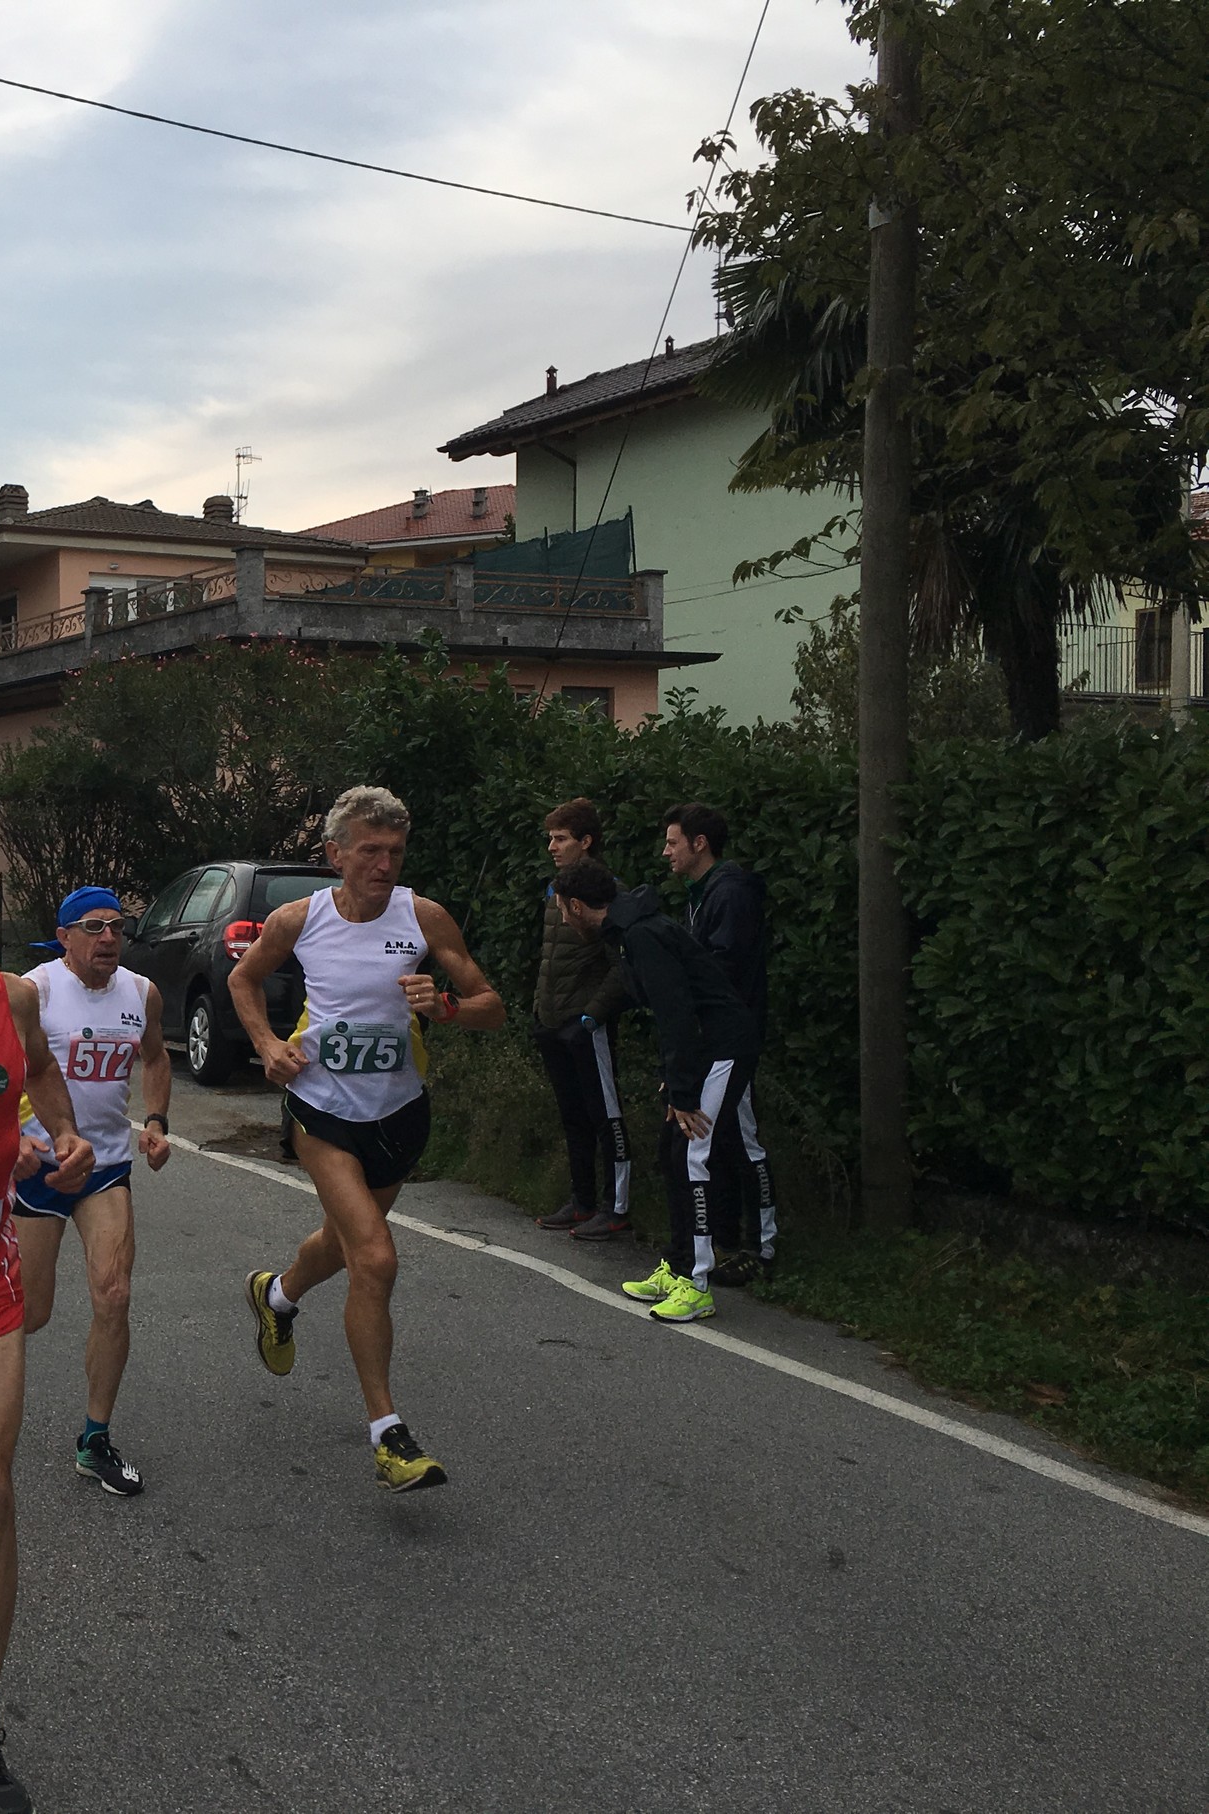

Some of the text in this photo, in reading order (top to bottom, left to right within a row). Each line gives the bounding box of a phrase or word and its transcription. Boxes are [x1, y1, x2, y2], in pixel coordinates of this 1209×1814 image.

[384, 941, 418, 949] A.N.A.
[73, 1042, 134, 1078] 572
[325, 1034, 399, 1070] 375
